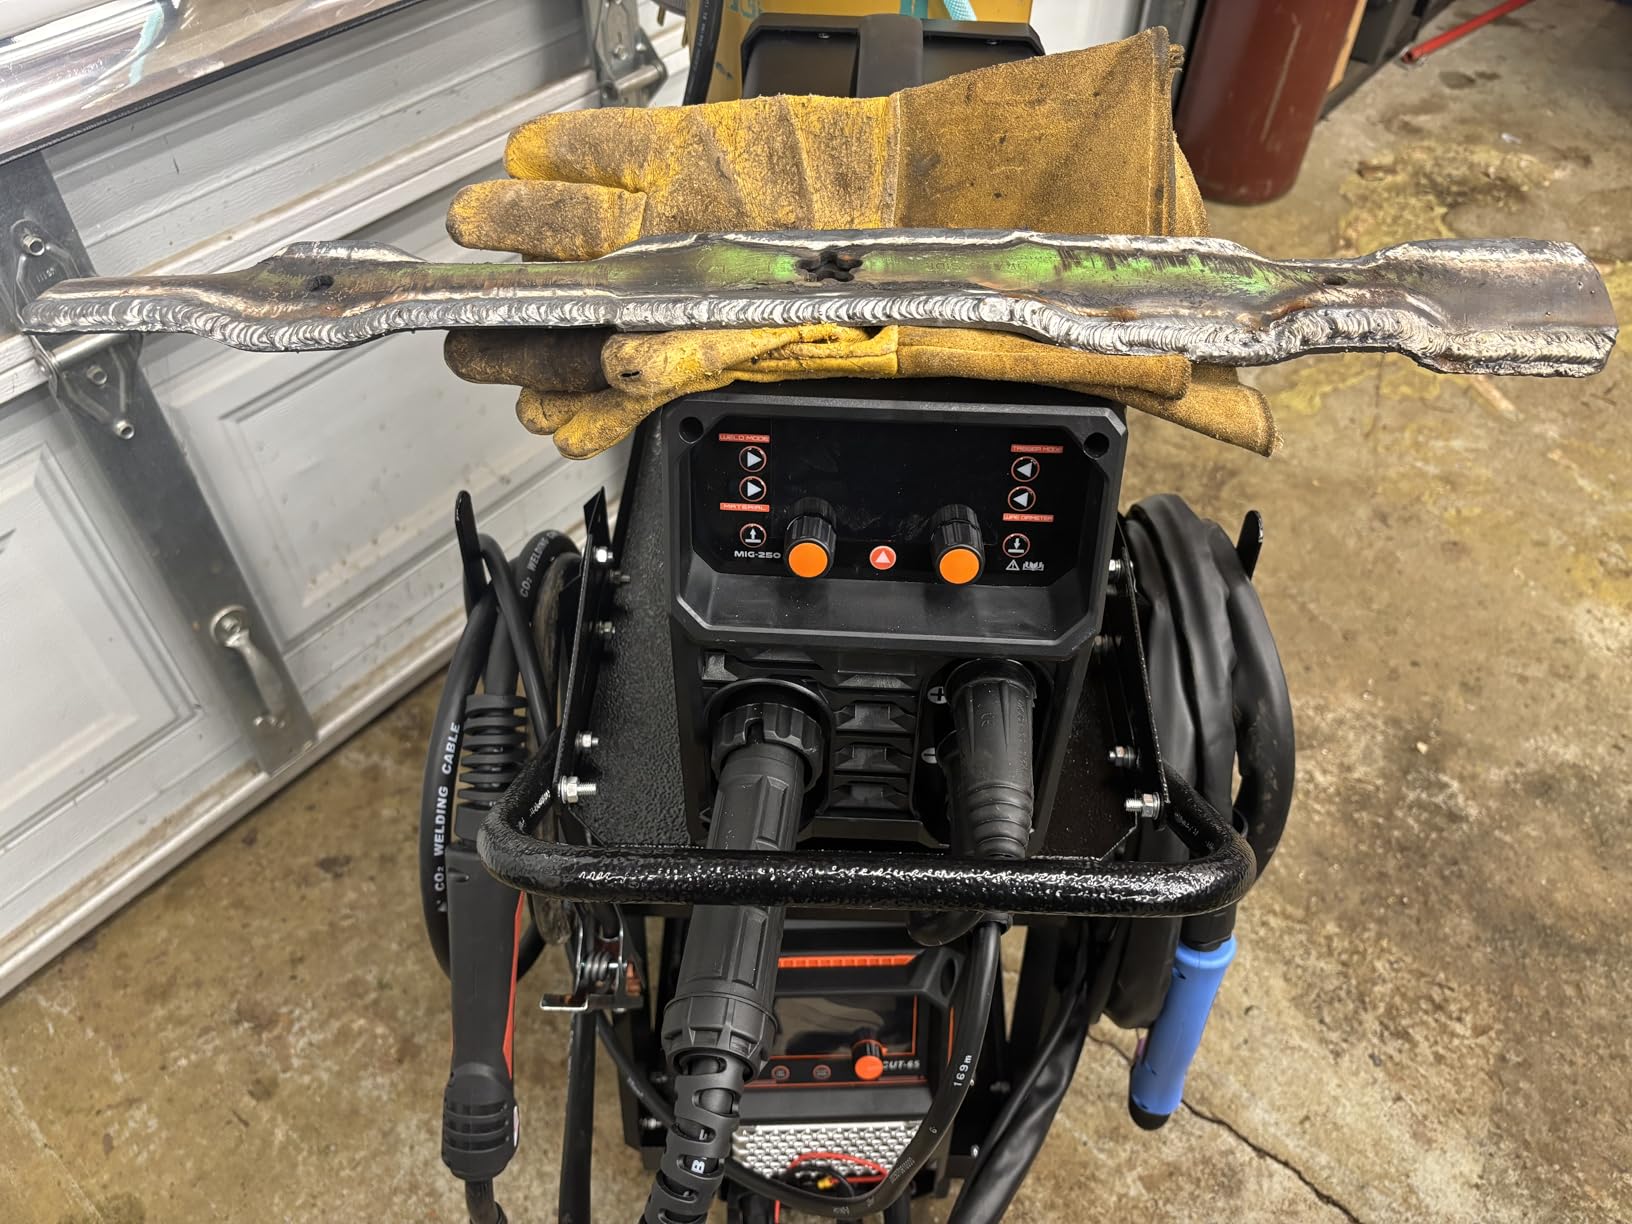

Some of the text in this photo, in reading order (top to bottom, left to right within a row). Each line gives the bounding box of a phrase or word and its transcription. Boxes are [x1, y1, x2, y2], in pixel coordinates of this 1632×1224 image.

[720, 434, 770, 443] WELD MODE
[722, 503, 766, 512] MATERIAL
[734, 550, 781, 559] MIG-250
[433, 786, 448, 857] WELDING
[442, 721, 461, 776] CABLE
[954, 1054, 973, 1087] 169m
